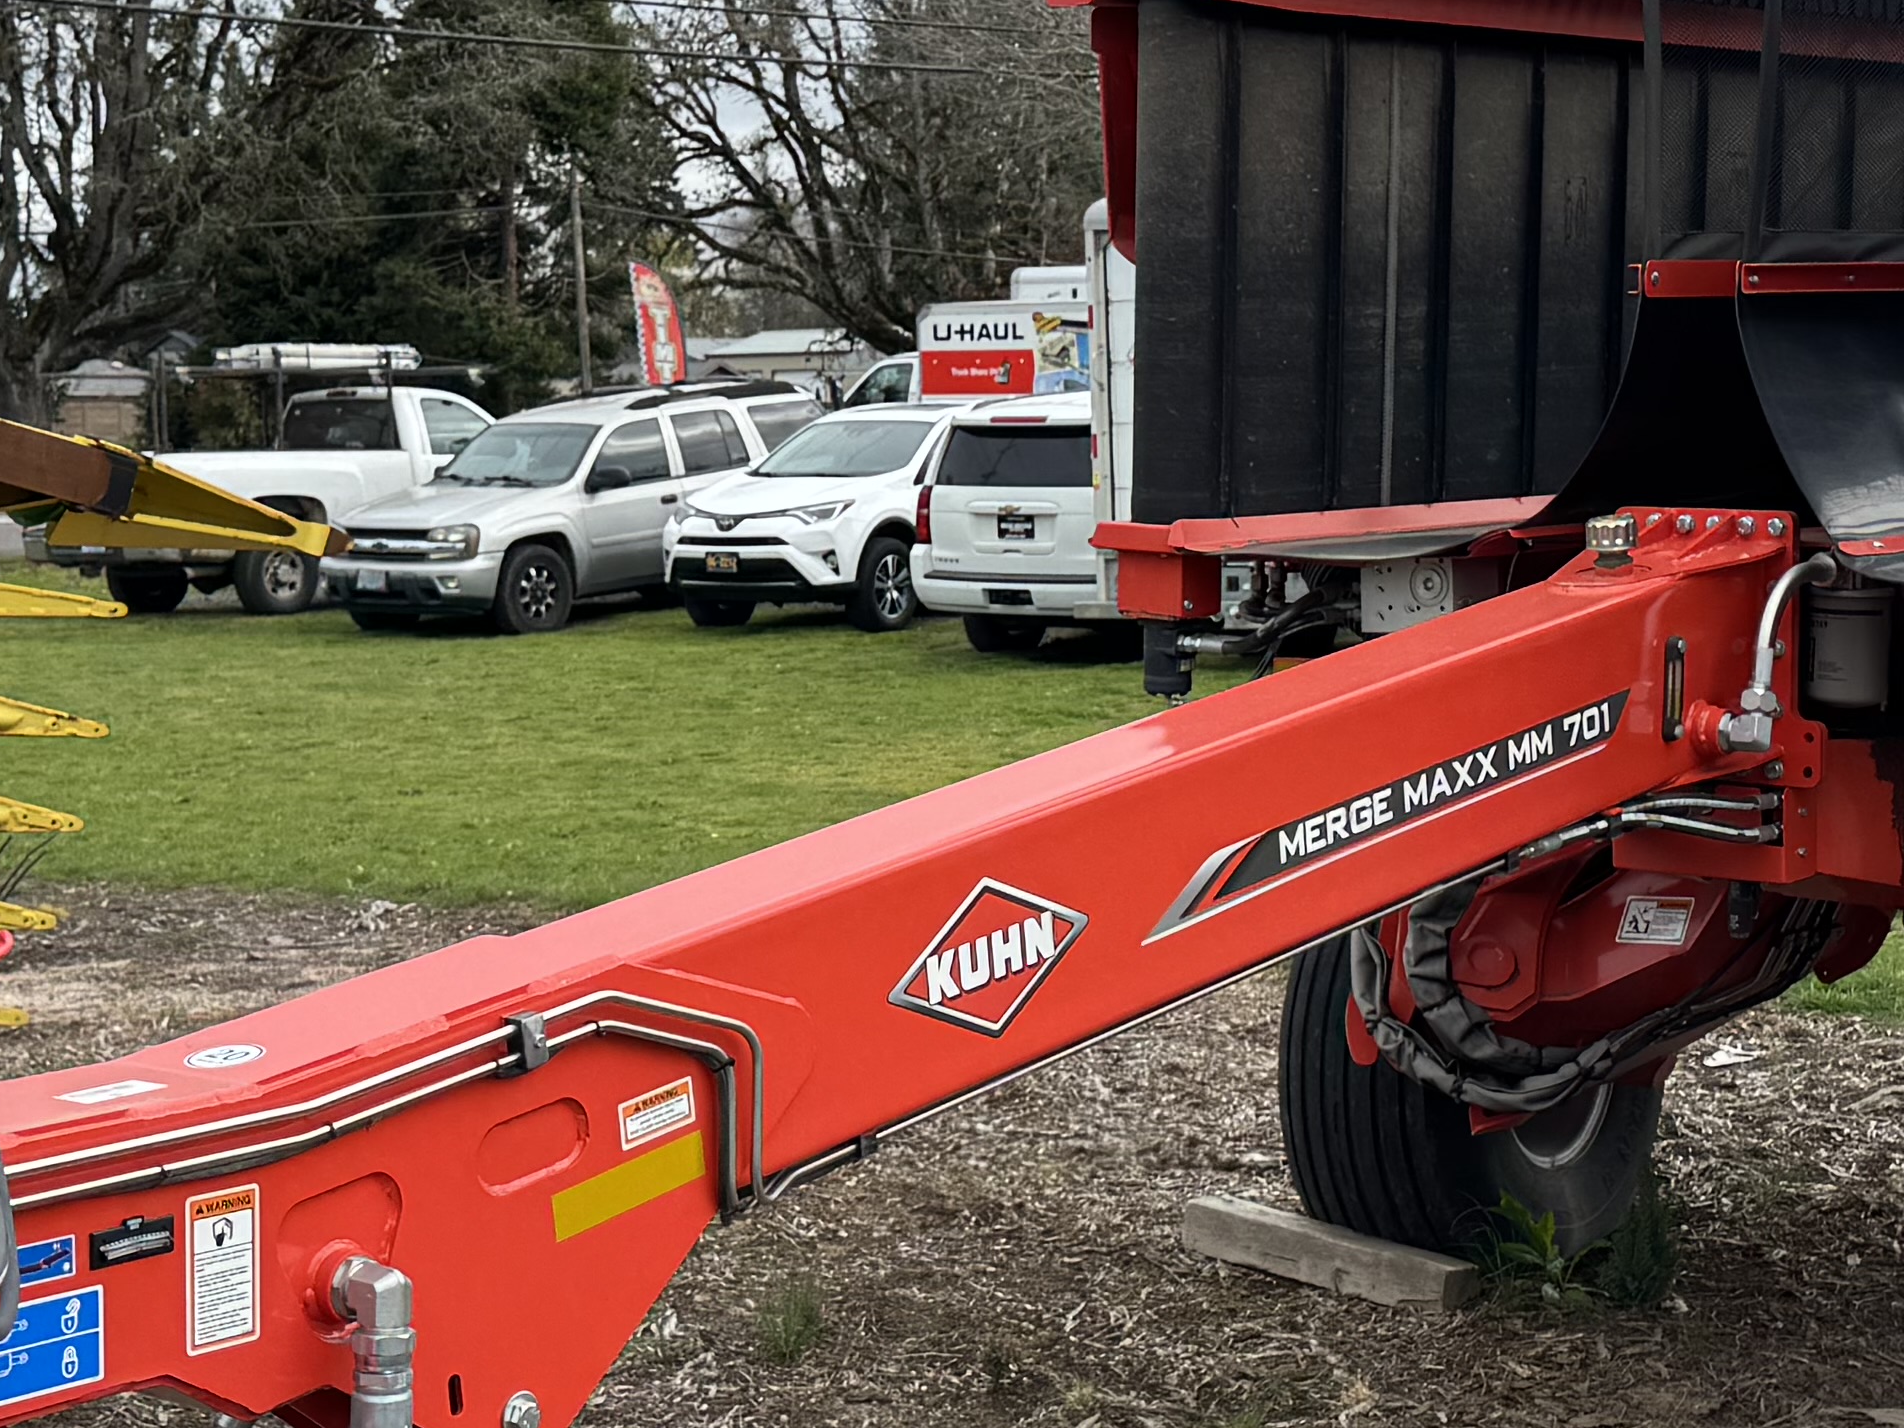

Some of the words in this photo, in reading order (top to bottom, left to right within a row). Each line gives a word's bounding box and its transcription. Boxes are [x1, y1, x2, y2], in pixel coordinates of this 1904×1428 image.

[933, 322, 1024, 341] U-HAUL
[1278, 787, 1394, 865] MERGE
[1403, 745, 1499, 813] MAXX
[1507, 723, 1554, 771] MM
[1562, 701, 1611, 747] 701
[925, 910, 1056, 1006] KUHN
[205, 1194, 251, 1213] WARNING
